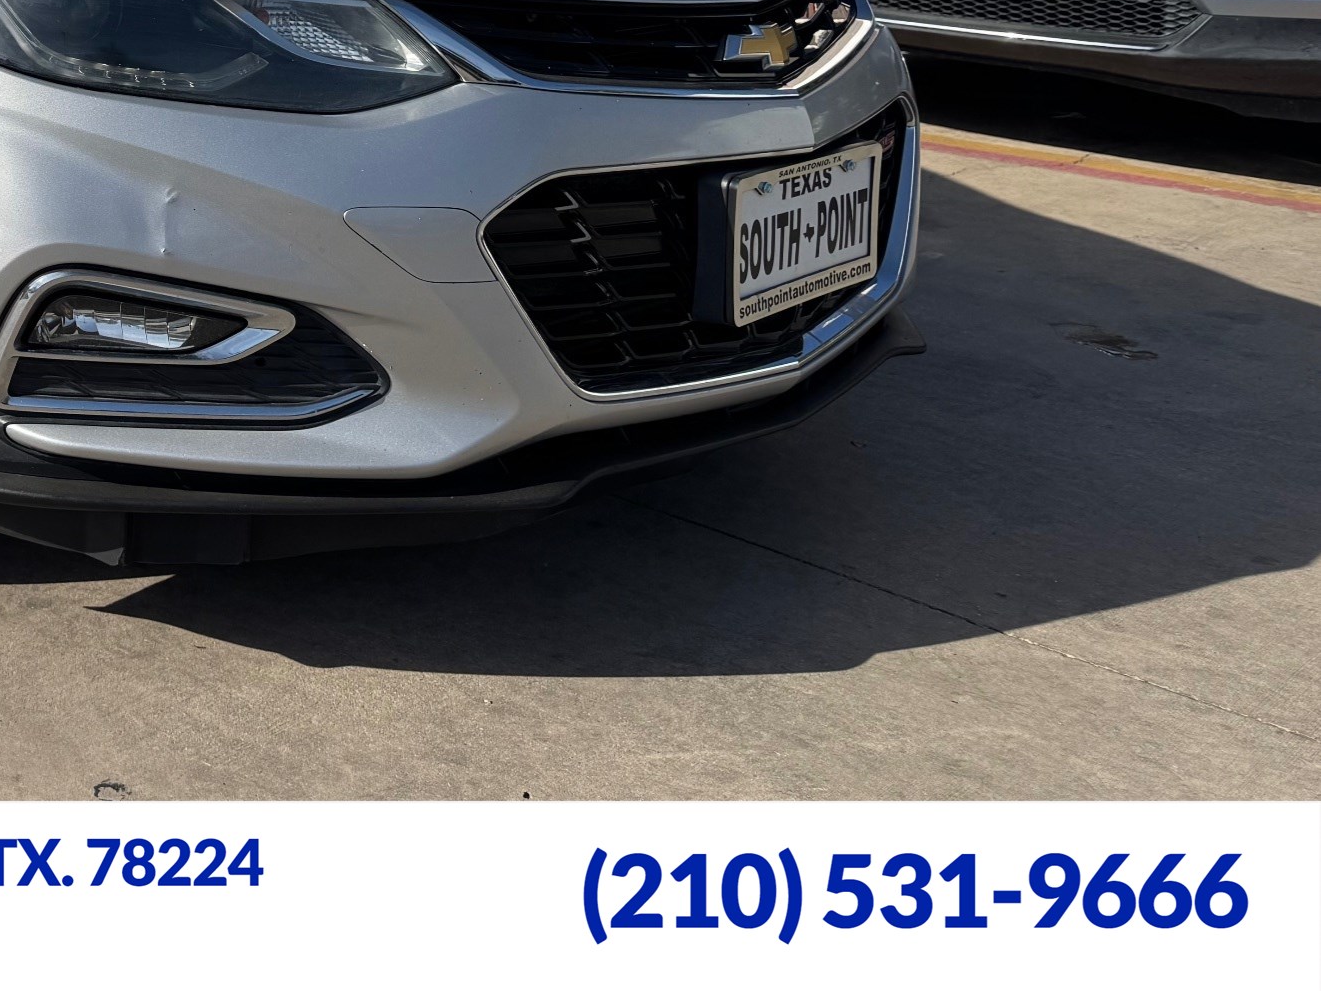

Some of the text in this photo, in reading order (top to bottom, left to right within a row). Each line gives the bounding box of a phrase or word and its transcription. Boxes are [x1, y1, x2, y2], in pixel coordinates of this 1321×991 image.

[779, 167, 797, 178] SAN
[832, 155, 842, 165] TX
[779, 168, 832, 200] TEXAS
[739, 188, 868, 284] SOUTH POINT
[739, 262, 871, 319] southpointautomotive.com
